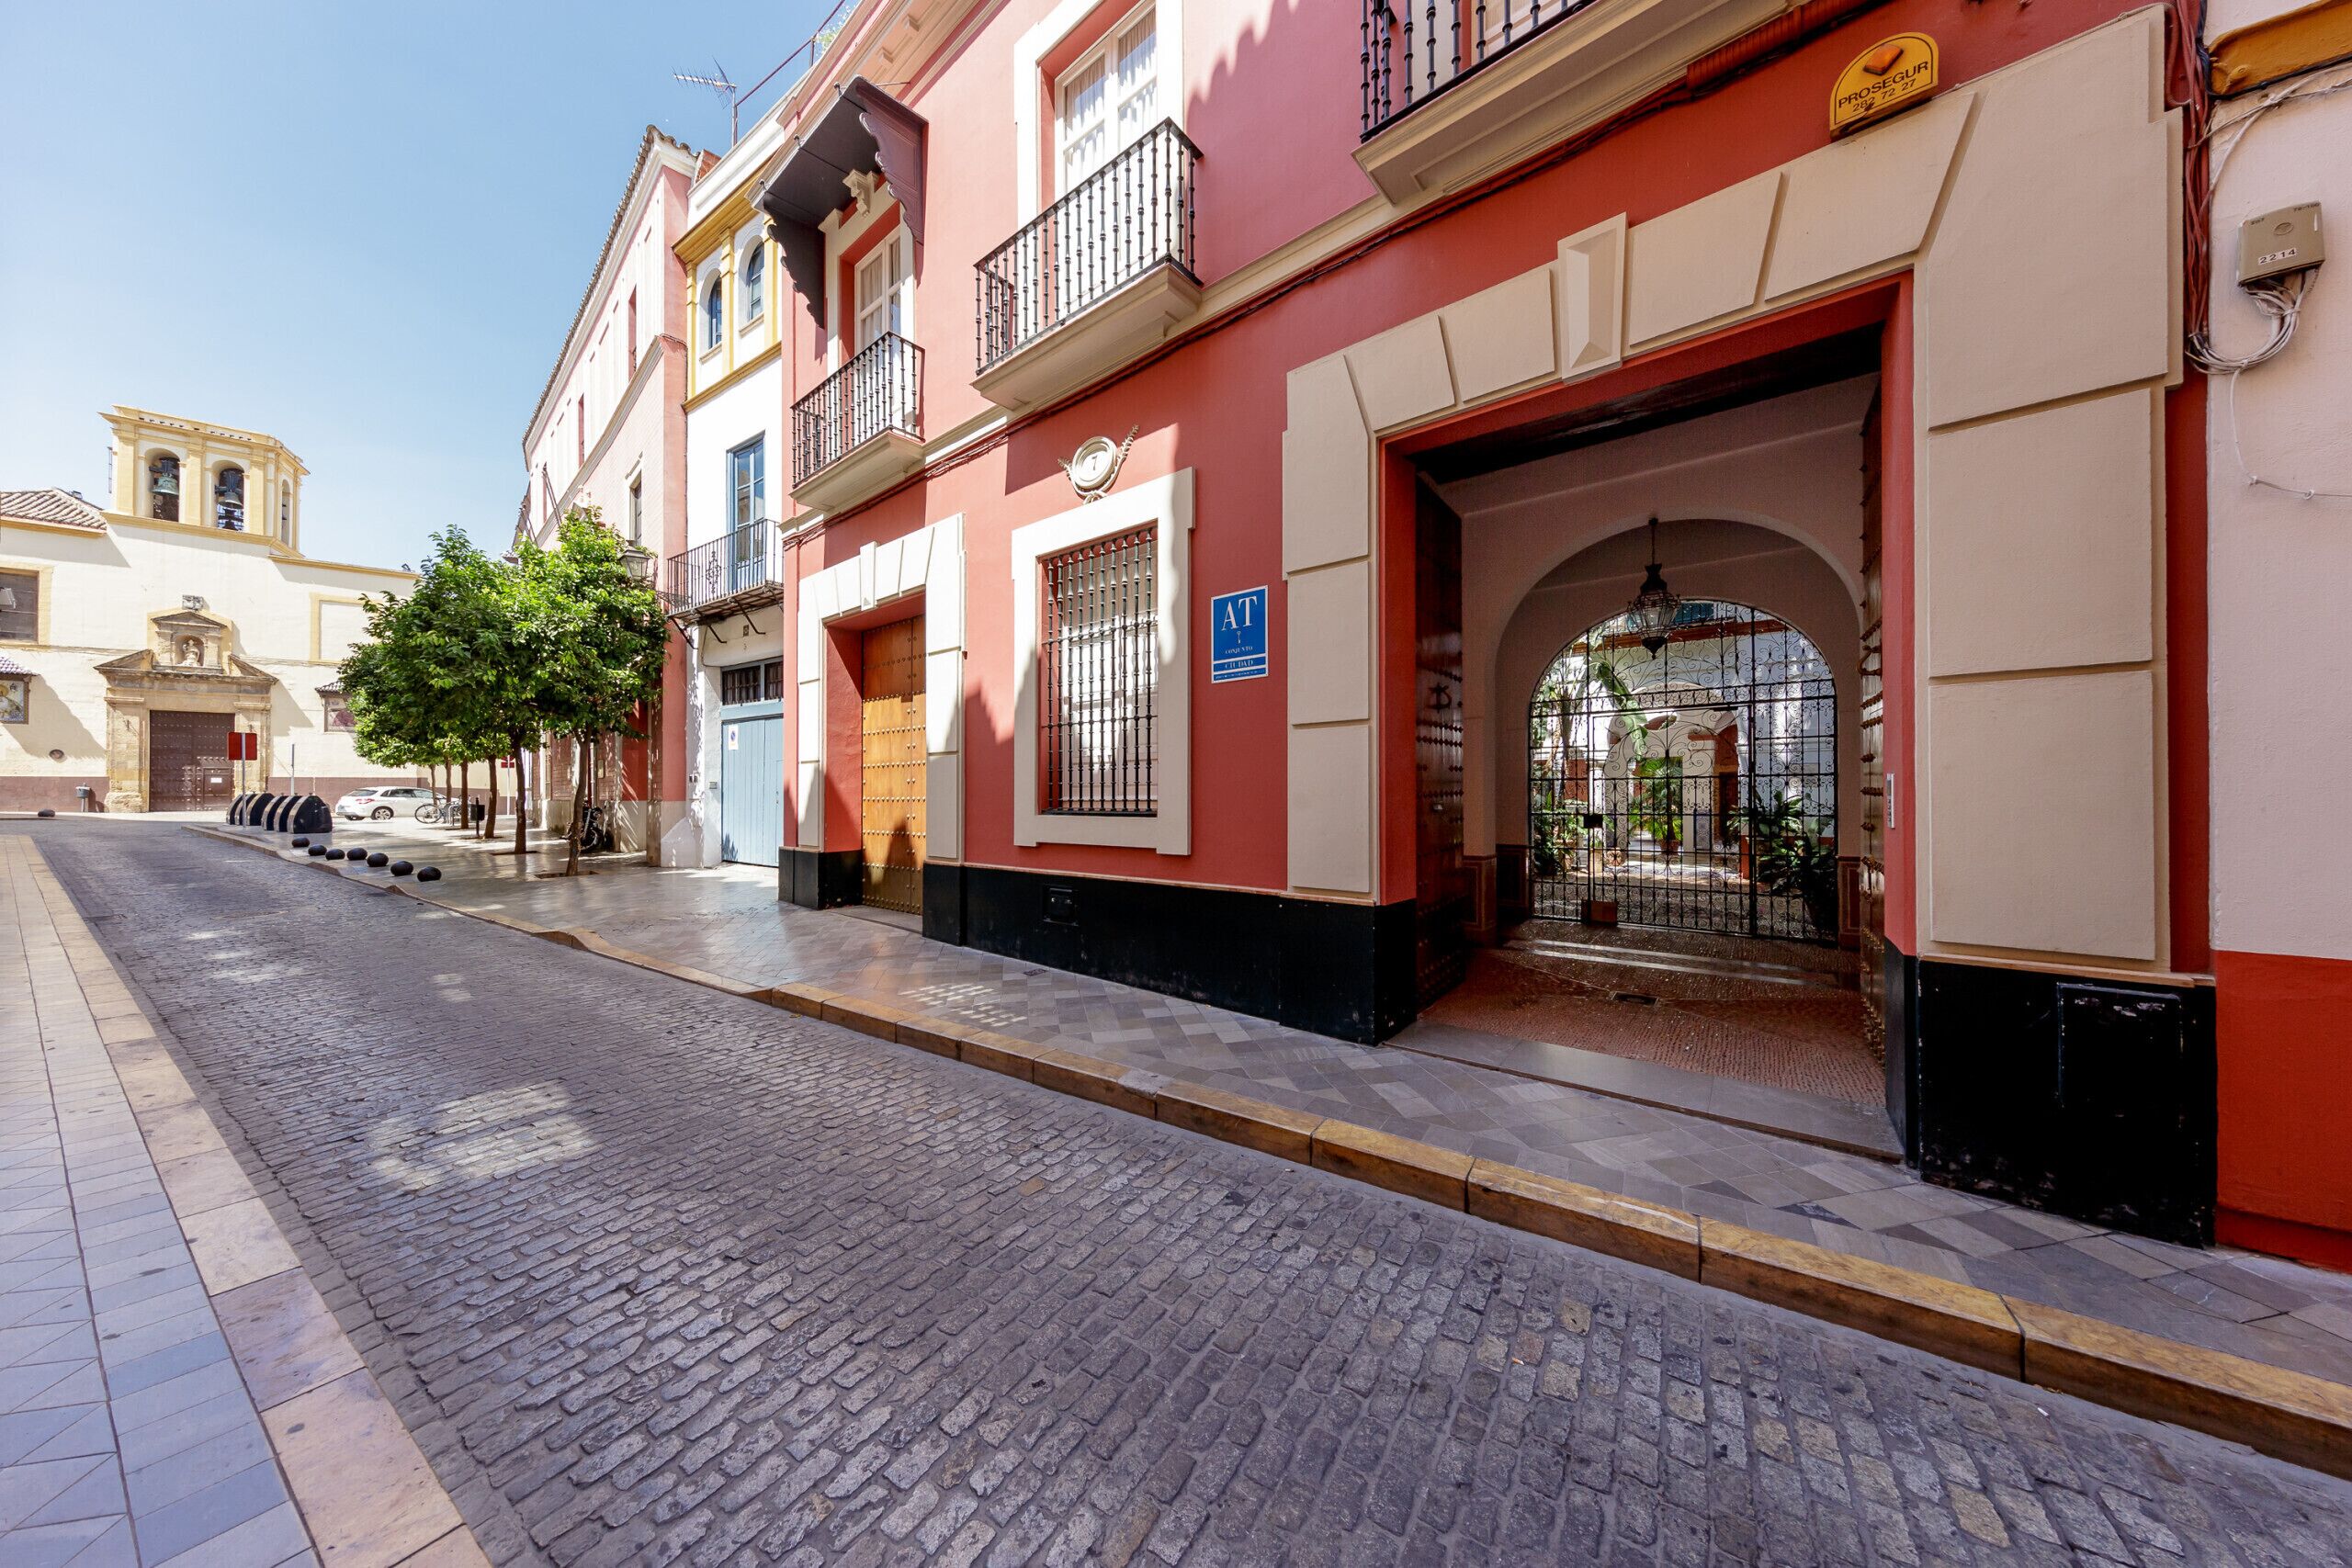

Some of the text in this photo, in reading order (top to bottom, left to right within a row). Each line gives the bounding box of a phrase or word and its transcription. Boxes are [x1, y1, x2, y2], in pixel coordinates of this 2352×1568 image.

[1838, 61, 1928, 108] PROSEGUR
[1881, 87, 1895, 100] 72
[1901, 78, 1917, 91] 27
[1091, 455, 1098, 471] 7
[1221, 596, 1258, 631] AT
